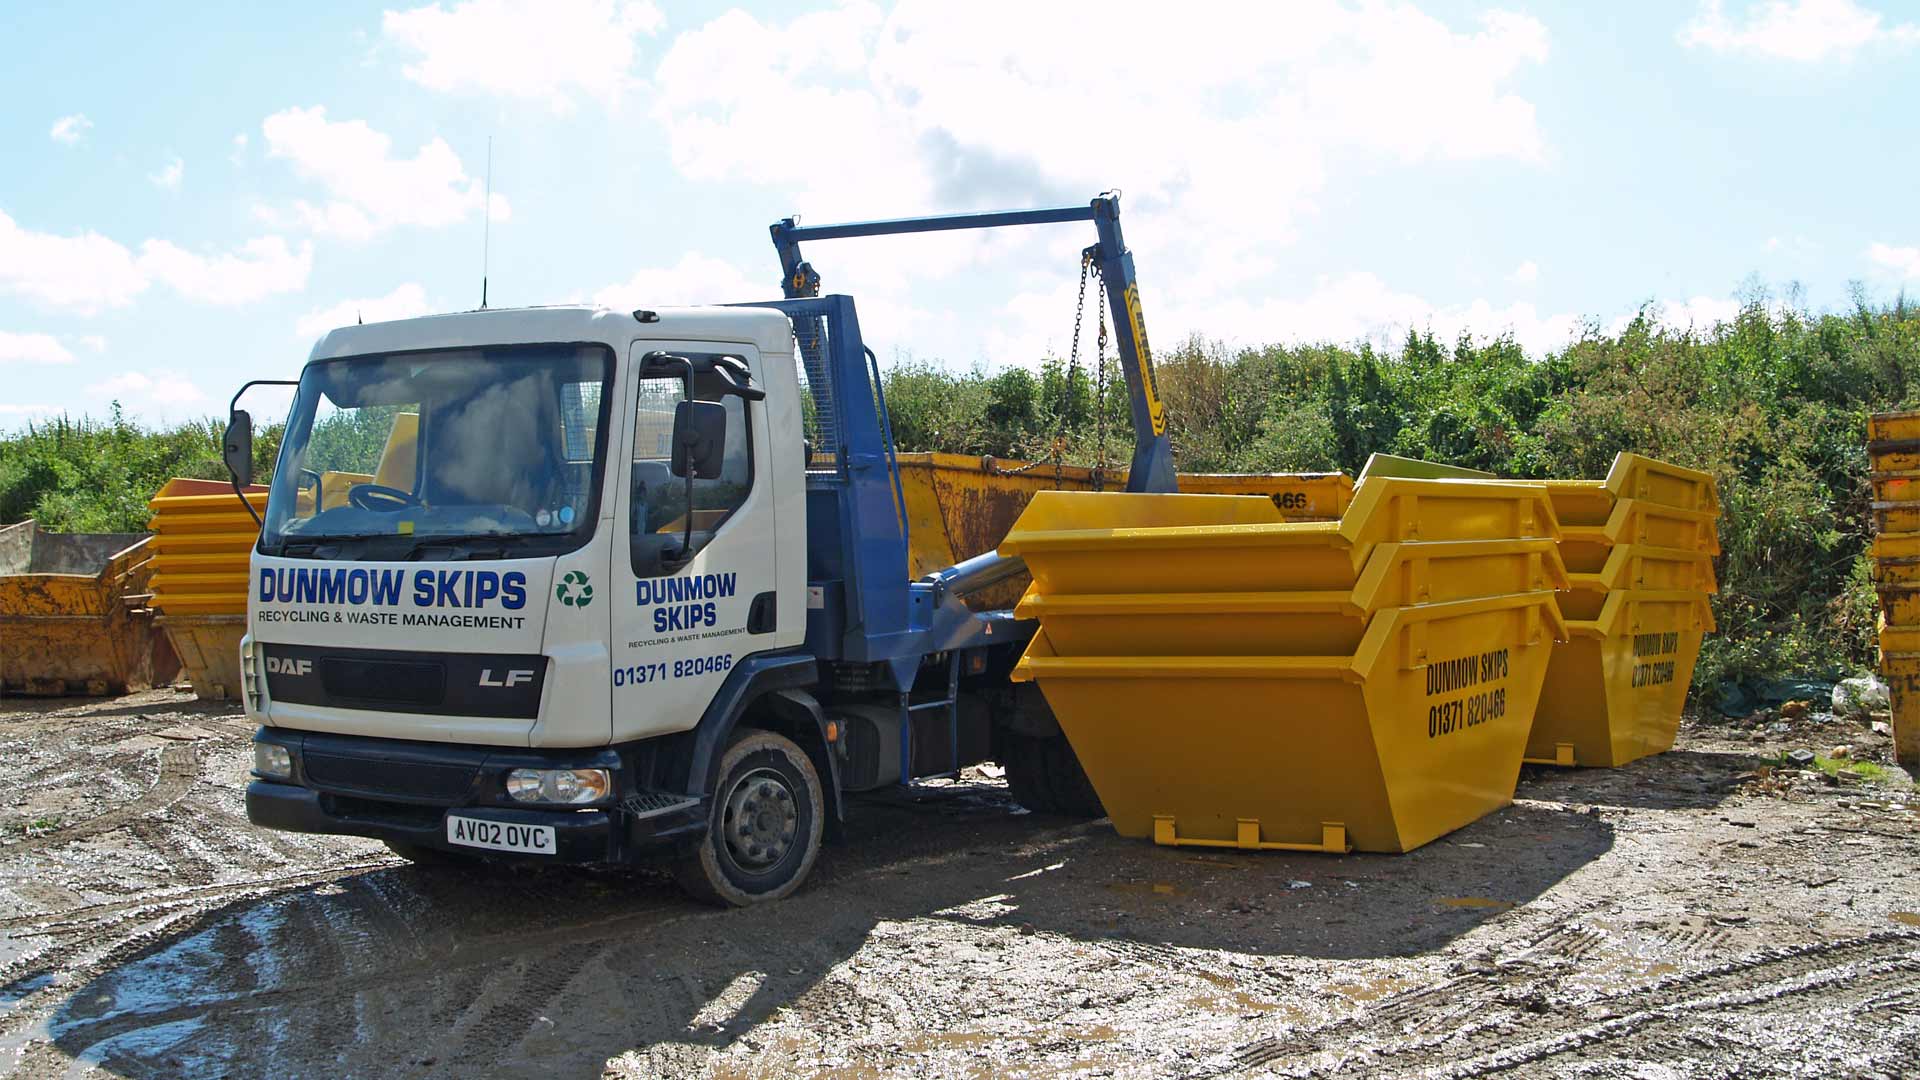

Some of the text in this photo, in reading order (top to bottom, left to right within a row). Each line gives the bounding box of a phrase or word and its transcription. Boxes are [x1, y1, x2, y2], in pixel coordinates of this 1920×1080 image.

[259, 568, 526, 610] DUNMOW SKIPS
[636, 572, 737, 606] DUNMOW
[258, 610, 526, 629] RECYCLING & WASTE MANAGEMENT
[653, 602, 717, 633] SKIPS
[628, 636, 670, 649] RECYCLING
[678, 632, 701, 643] WASTE
[701, 627, 746, 640] MANAGEMENT
[1632, 631, 1678, 657] DUNMOW SKIPS
[266, 656, 313, 676] DAF
[479, 669, 536, 688] LF
[613, 653, 733, 688] 01371 820466
[1426, 647, 1509, 697] DUNMOW SKIPS
[1631, 662, 1651, 689] 01371
[1428, 687, 1506, 739] 01371 820466
[456, 819, 546, 849] AV02 OVC
